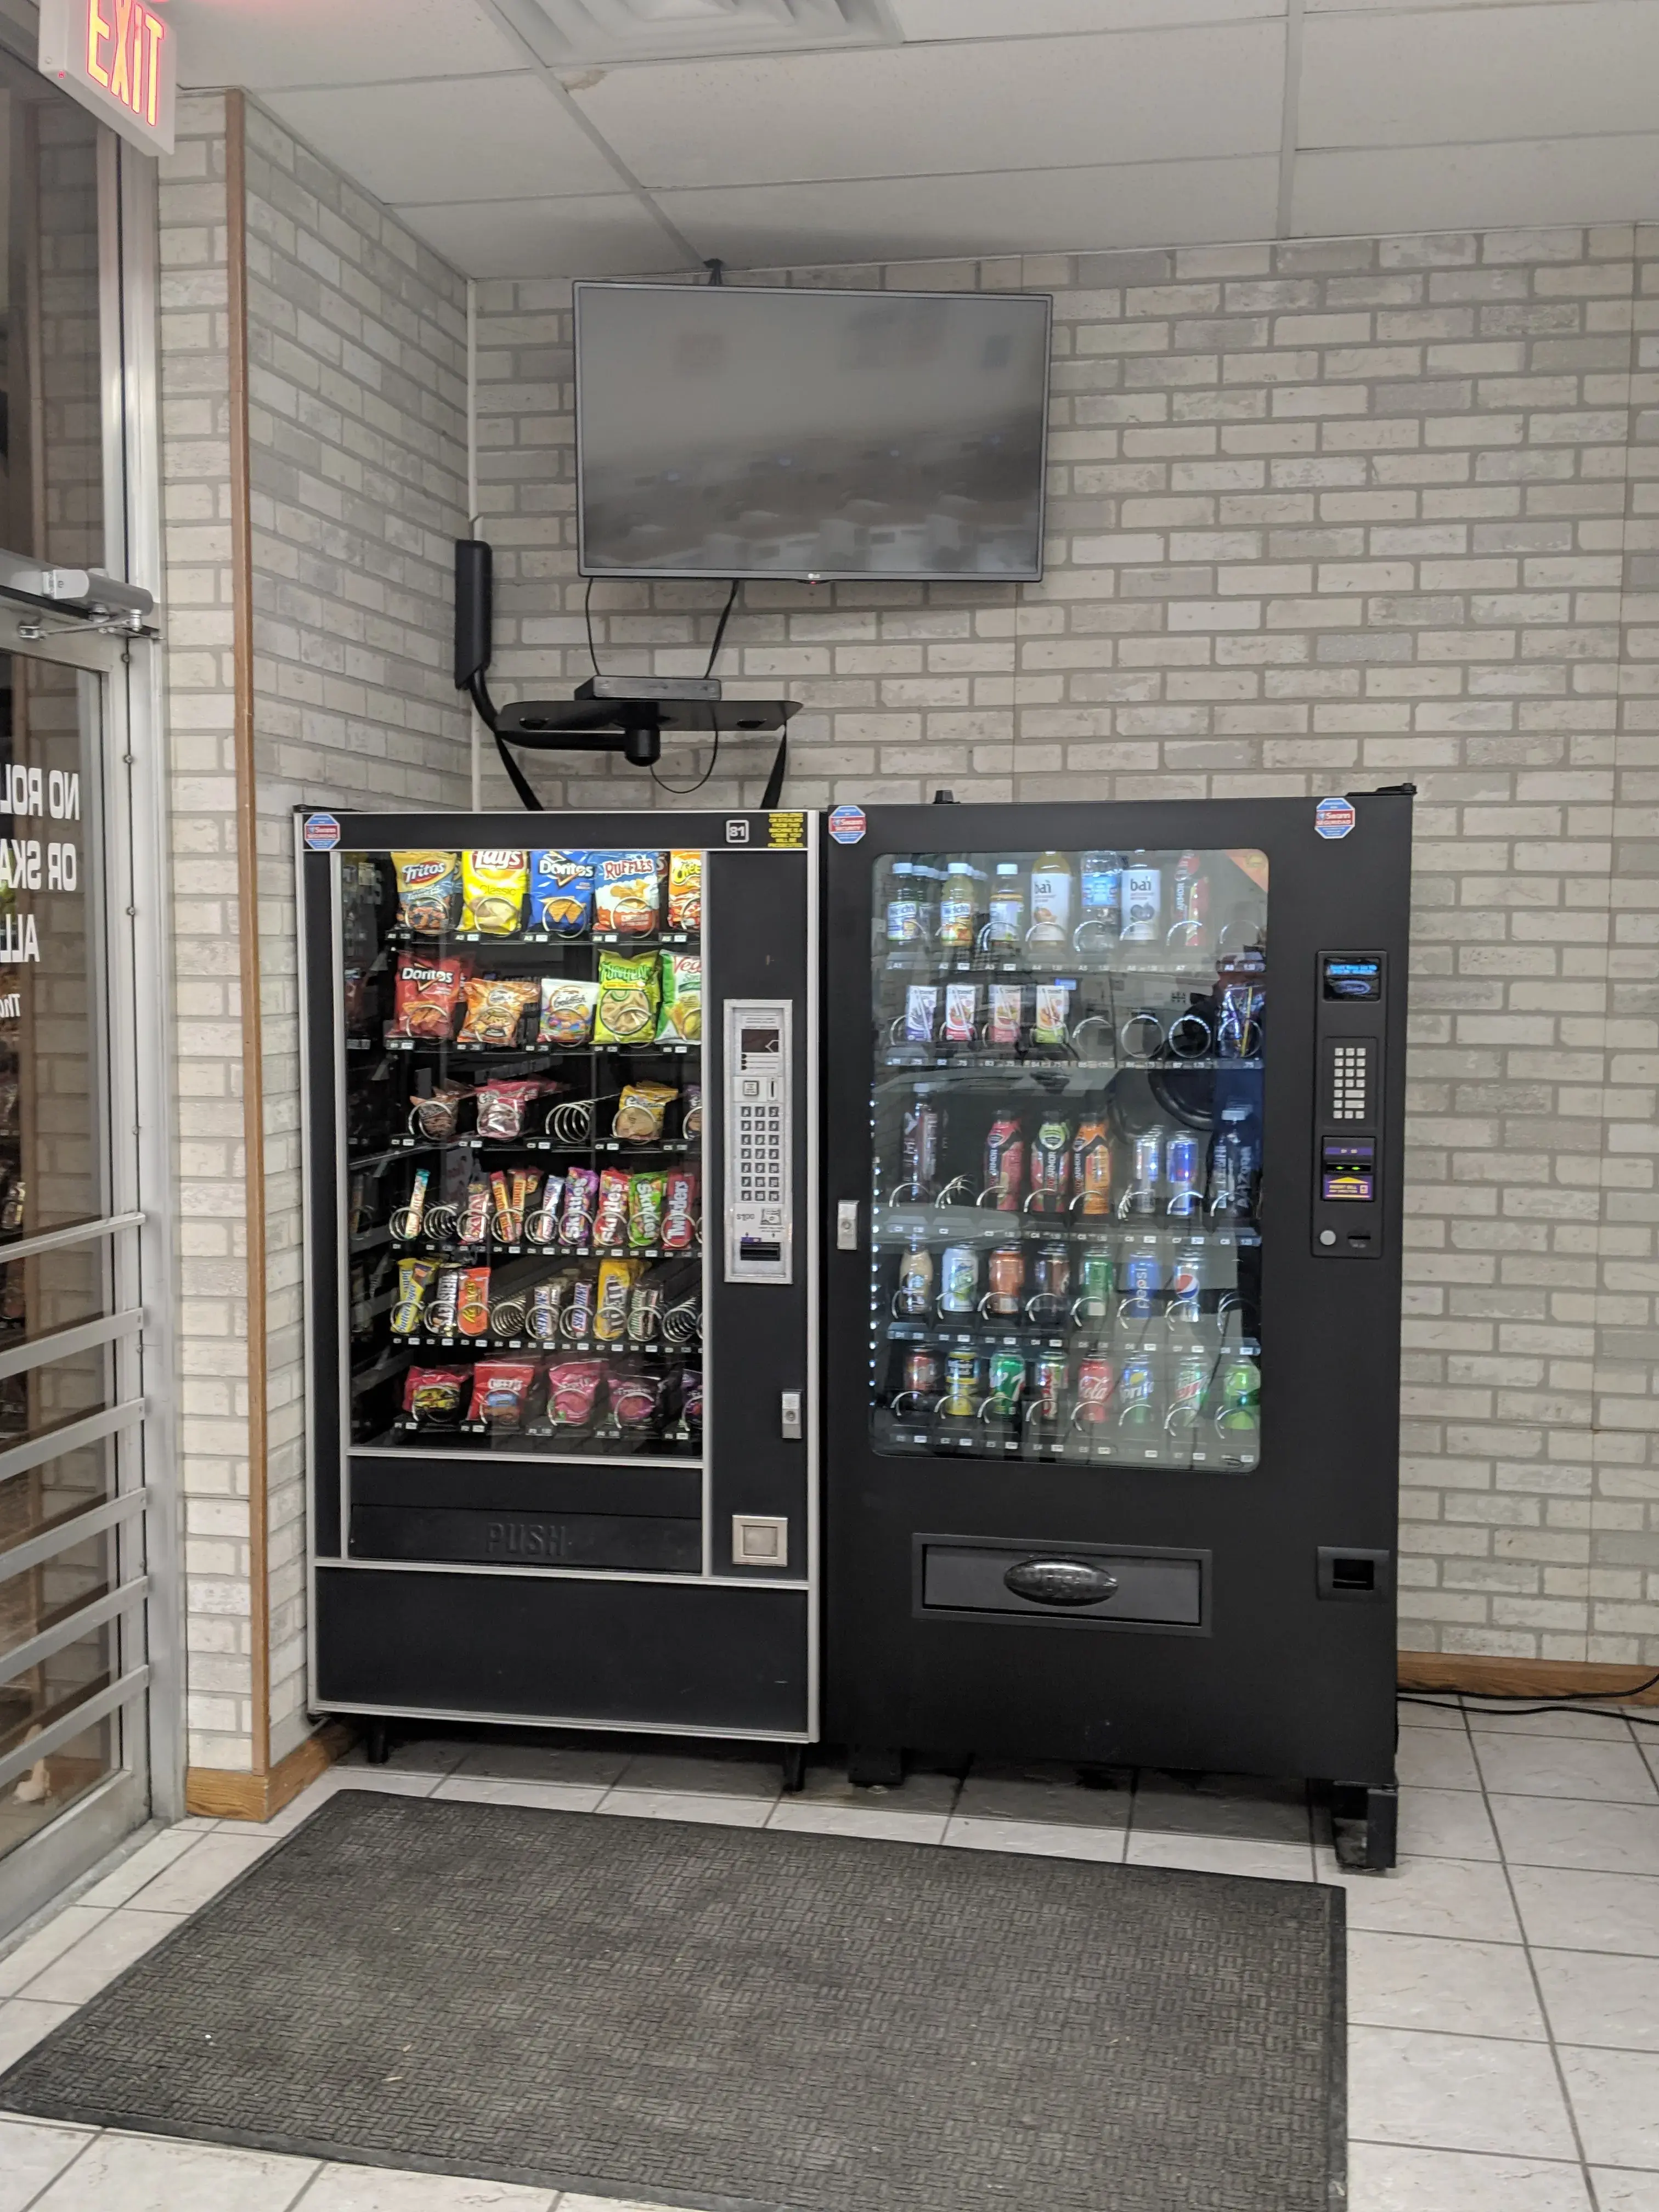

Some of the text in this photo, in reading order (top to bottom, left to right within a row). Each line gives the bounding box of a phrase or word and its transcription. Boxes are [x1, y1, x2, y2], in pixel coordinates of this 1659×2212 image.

[86, 0, 164, 126] EXIT
[402, 862, 446, 883] Fritos
[539, 860, 595, 877] Doritos
[603, 859, 654, 879] RUFFLES
[1130, 876, 1152, 891] bai
[402, 967, 454, 984] Doritos
[1136, 1267, 1151, 1309] pepsi
[486, 1522, 566, 1556] PUSH
